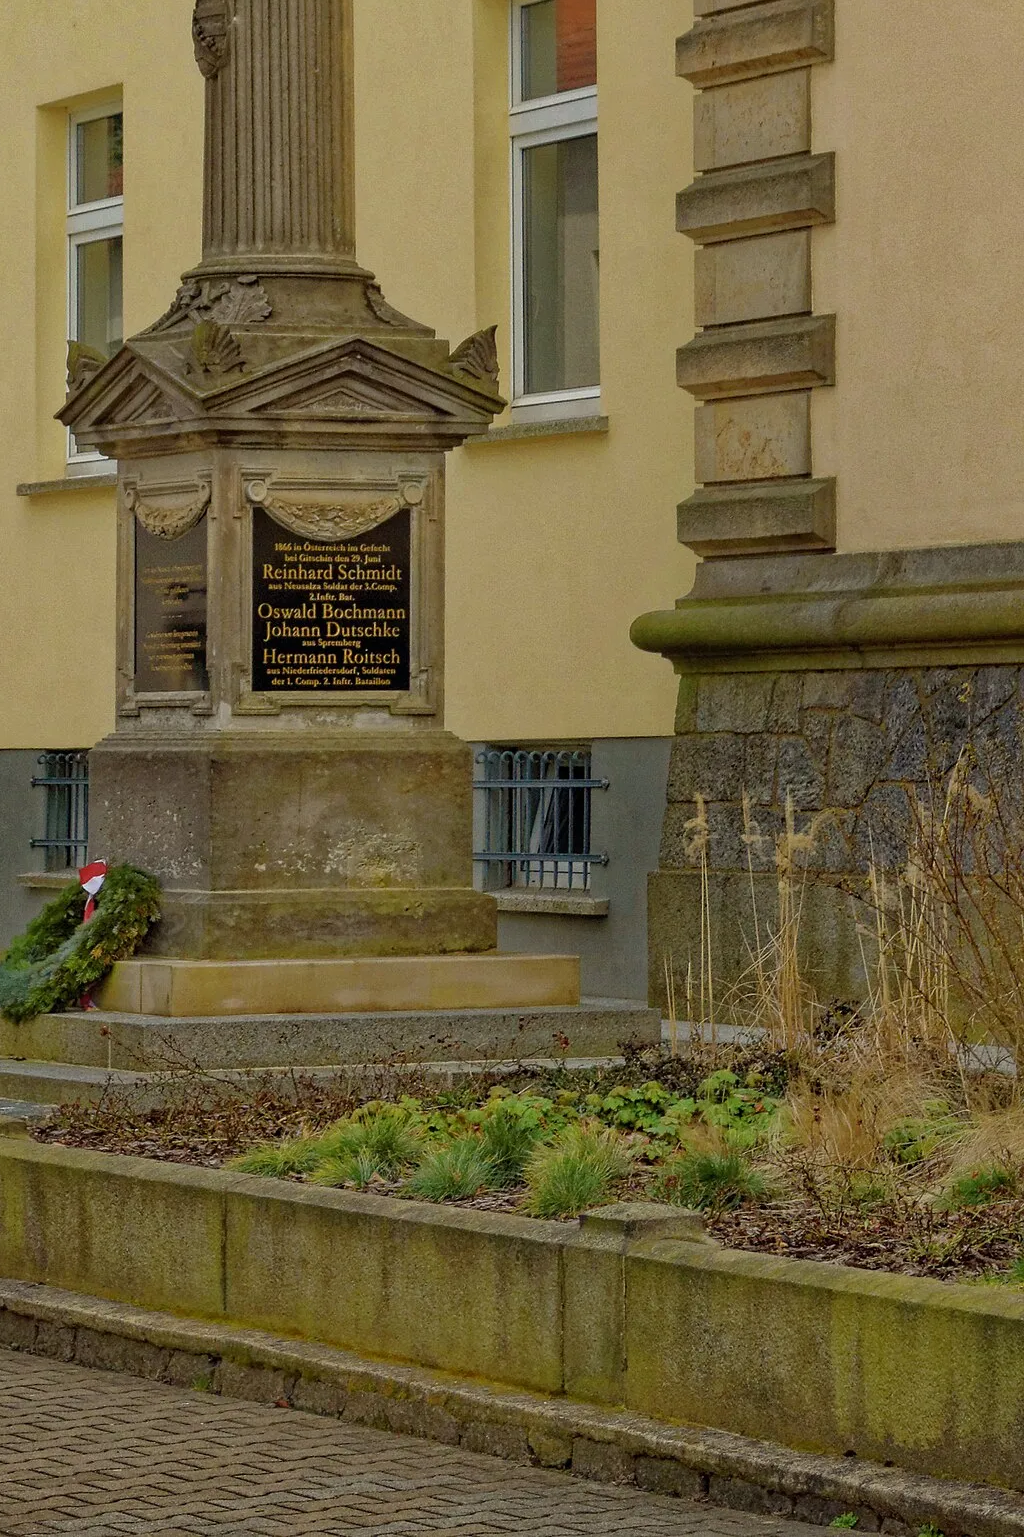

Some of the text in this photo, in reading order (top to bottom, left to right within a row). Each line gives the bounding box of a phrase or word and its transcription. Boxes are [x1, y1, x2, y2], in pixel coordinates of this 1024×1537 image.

[275, 543, 292, 551] 1866
[285, 554, 297, 562] bei
[299, 554, 333, 562] Gitschin
[364, 555, 381, 564] Juni
[263, 564, 402, 580] Reinhard Schmidt
[284, 582, 321, 590] Neusalza
[323, 582, 347, 590] Soldat
[258, 603, 405, 619] Oswald Bochmann
[263, 621, 400, 642] Johann Dutschke
[318, 638, 361, 648] Spremberg
[263, 649, 400, 664] Hermann Roitsch
[295, 678, 321, 687] Comp.
[323, 677, 330, 685] 2.
